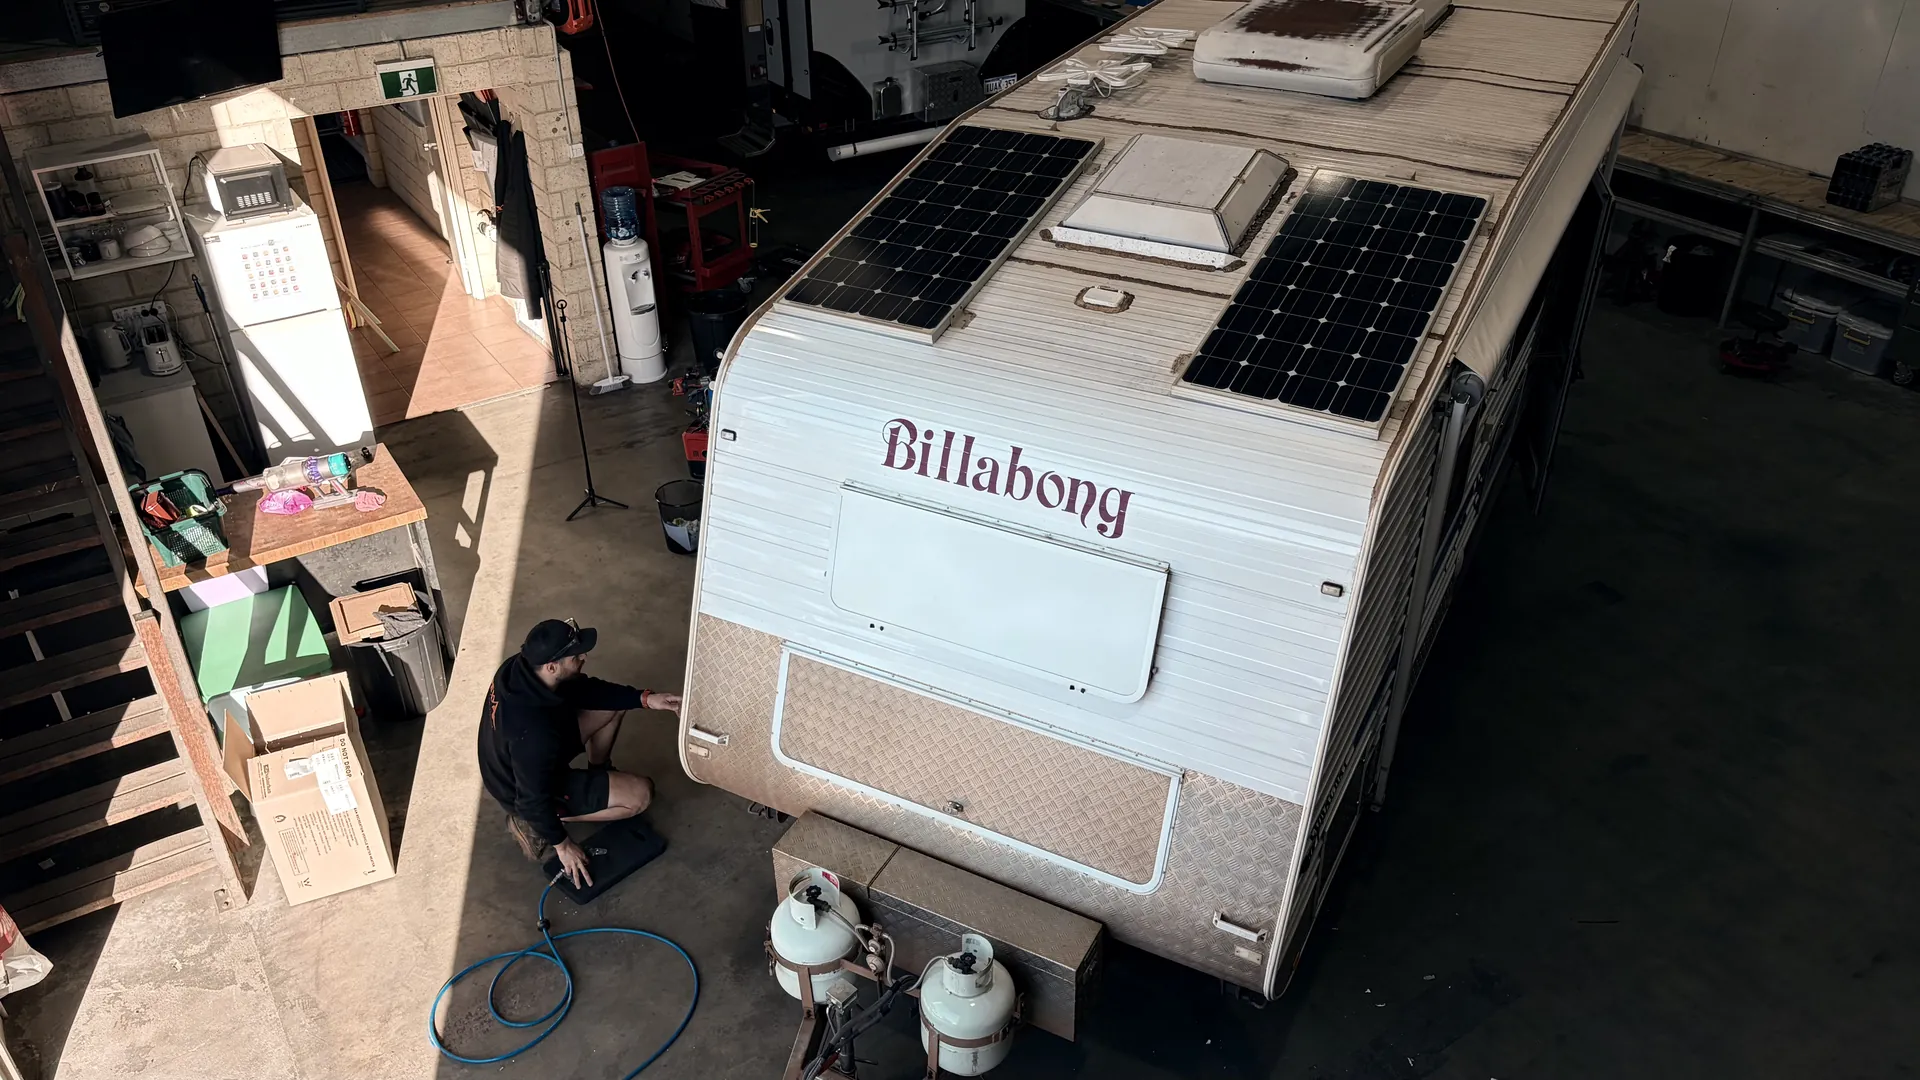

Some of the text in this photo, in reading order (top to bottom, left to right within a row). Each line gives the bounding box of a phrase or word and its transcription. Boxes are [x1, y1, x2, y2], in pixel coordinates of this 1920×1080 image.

[881, 418, 1136, 539] Billabong
[340, 738, 352, 778] DO NOT DROP
